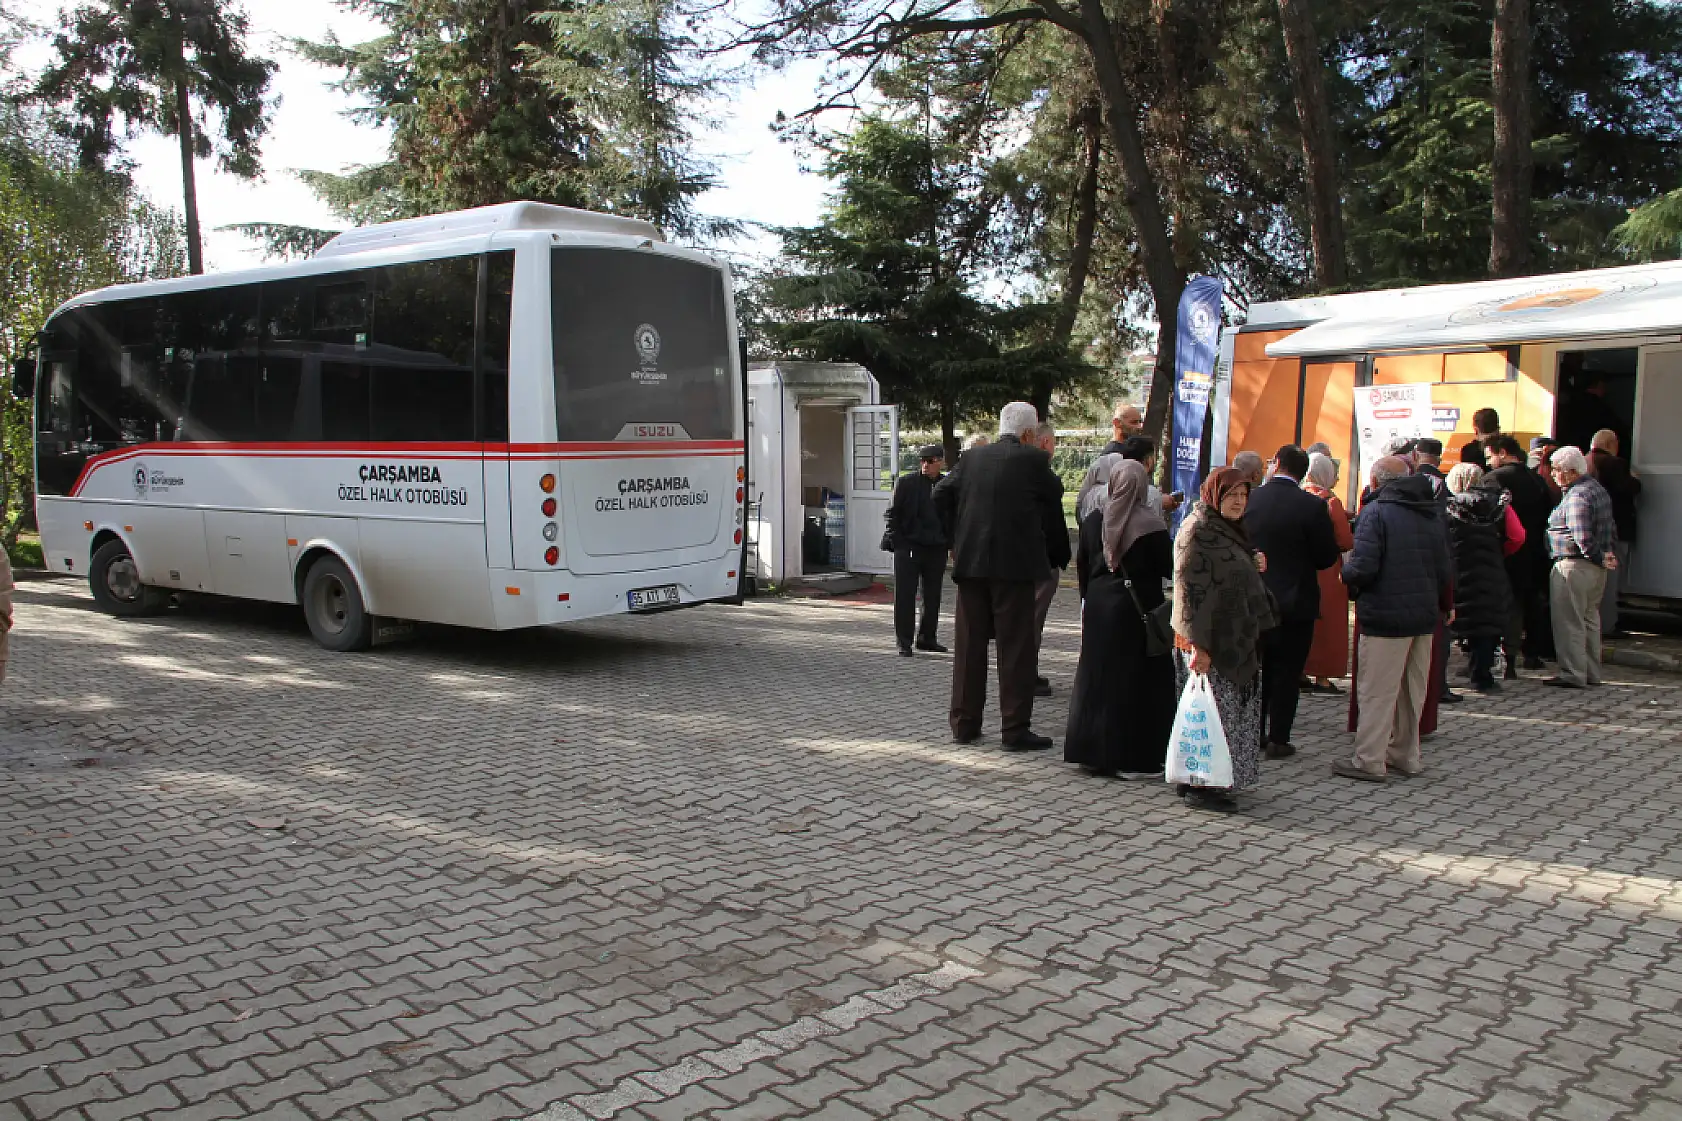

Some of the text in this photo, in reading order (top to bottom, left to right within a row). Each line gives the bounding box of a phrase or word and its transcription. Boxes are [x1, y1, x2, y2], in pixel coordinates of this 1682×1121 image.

[633, 427, 674, 437] ISUZU
[359, 464, 441, 484] ÇARŞAMBA
[338, 484, 467, 506] ÖZEL HALK OTOBÜSÜ
[617, 476, 690, 495] ÇARŞAMBA
[595, 489, 709, 512] ÖZEL HALK OTOBÜSÜ
